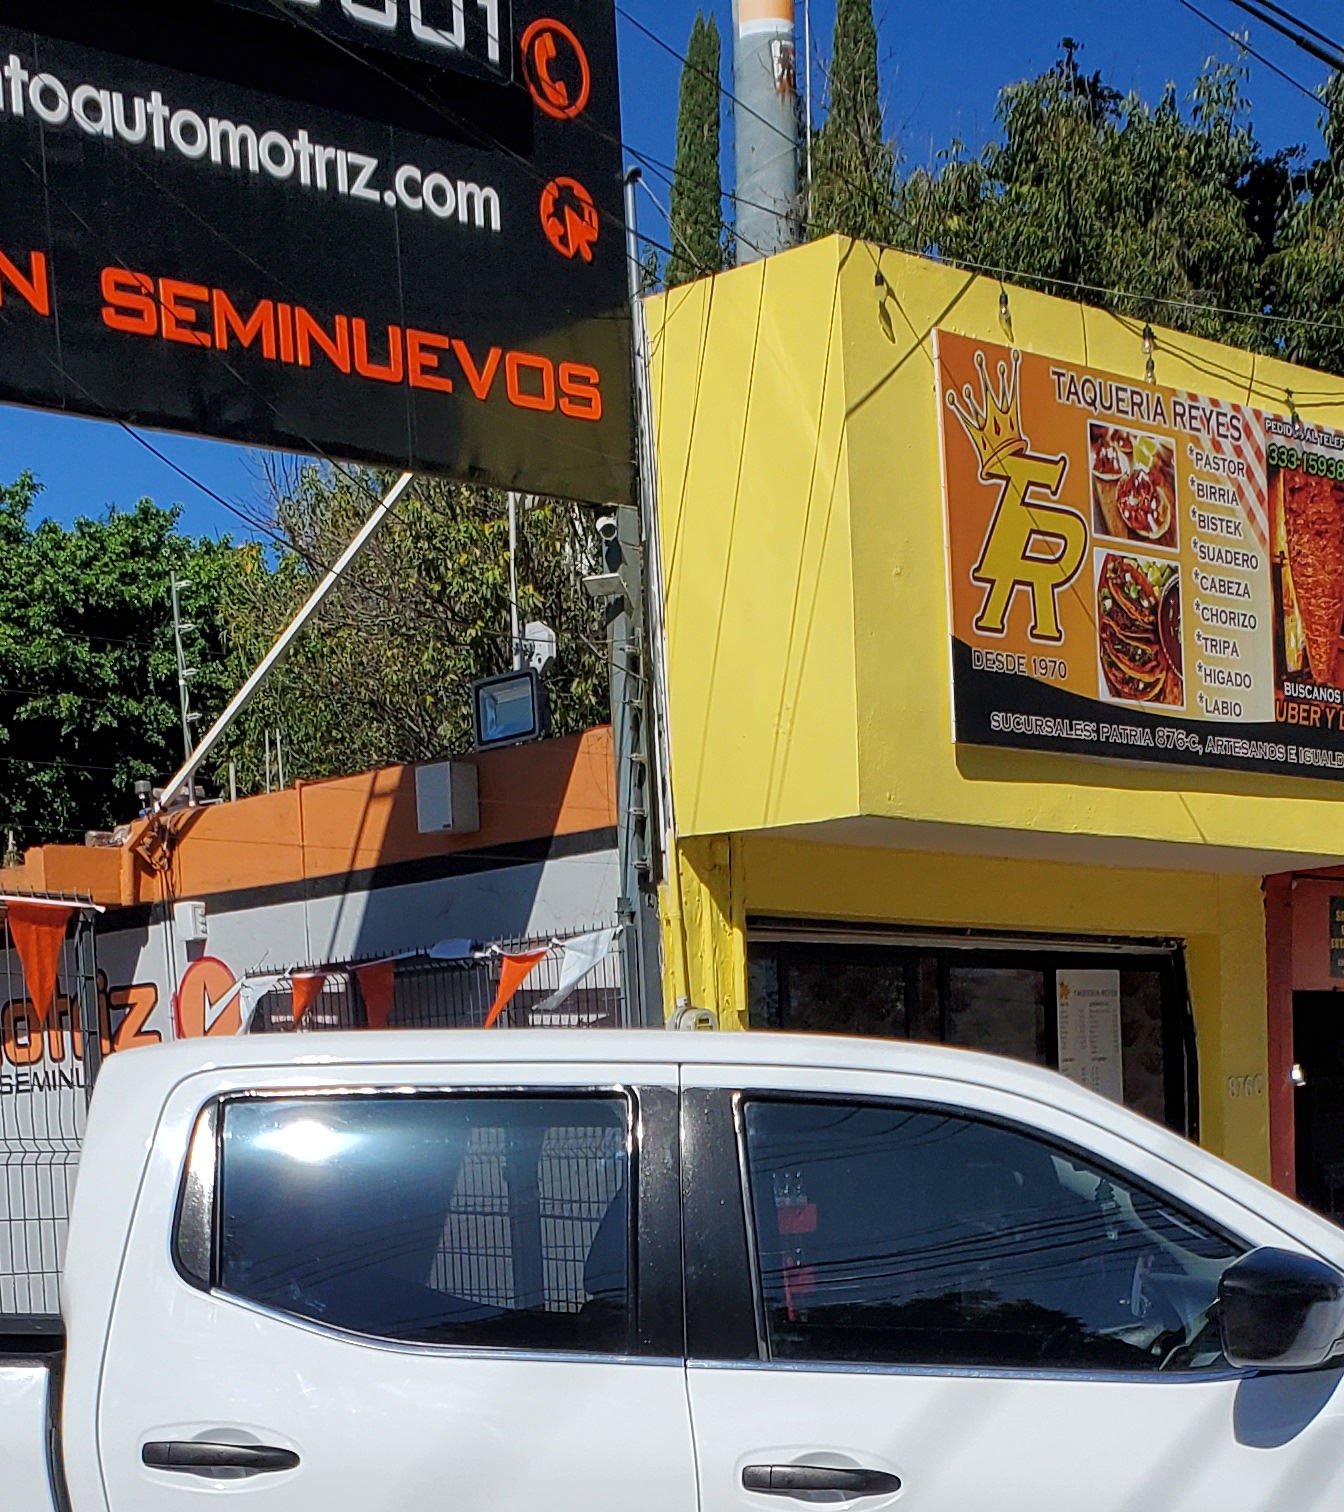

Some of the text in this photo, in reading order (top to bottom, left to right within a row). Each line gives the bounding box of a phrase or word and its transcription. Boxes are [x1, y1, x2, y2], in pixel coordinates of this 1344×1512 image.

[100, 266, 604, 422] SEMINUEVOS
[1051, 368, 1242, 443] TAQUERIA REYES
[1305, 429, 1318, 443] AL
[971, 649, 1068, 680] DESDE 1970
[1284, 681, 1341, 705] BUSCANOS
[1274, 703, 1322, 728] UBER
[1324, 707, 1336, 728] Y
[990, 711, 1098, 743] SUCURSALES:
[1099, 724, 1154, 748] PATRIA
[1205, 736, 1286, 763] ARTESANOS
[1287, 746, 1298, 764] E
